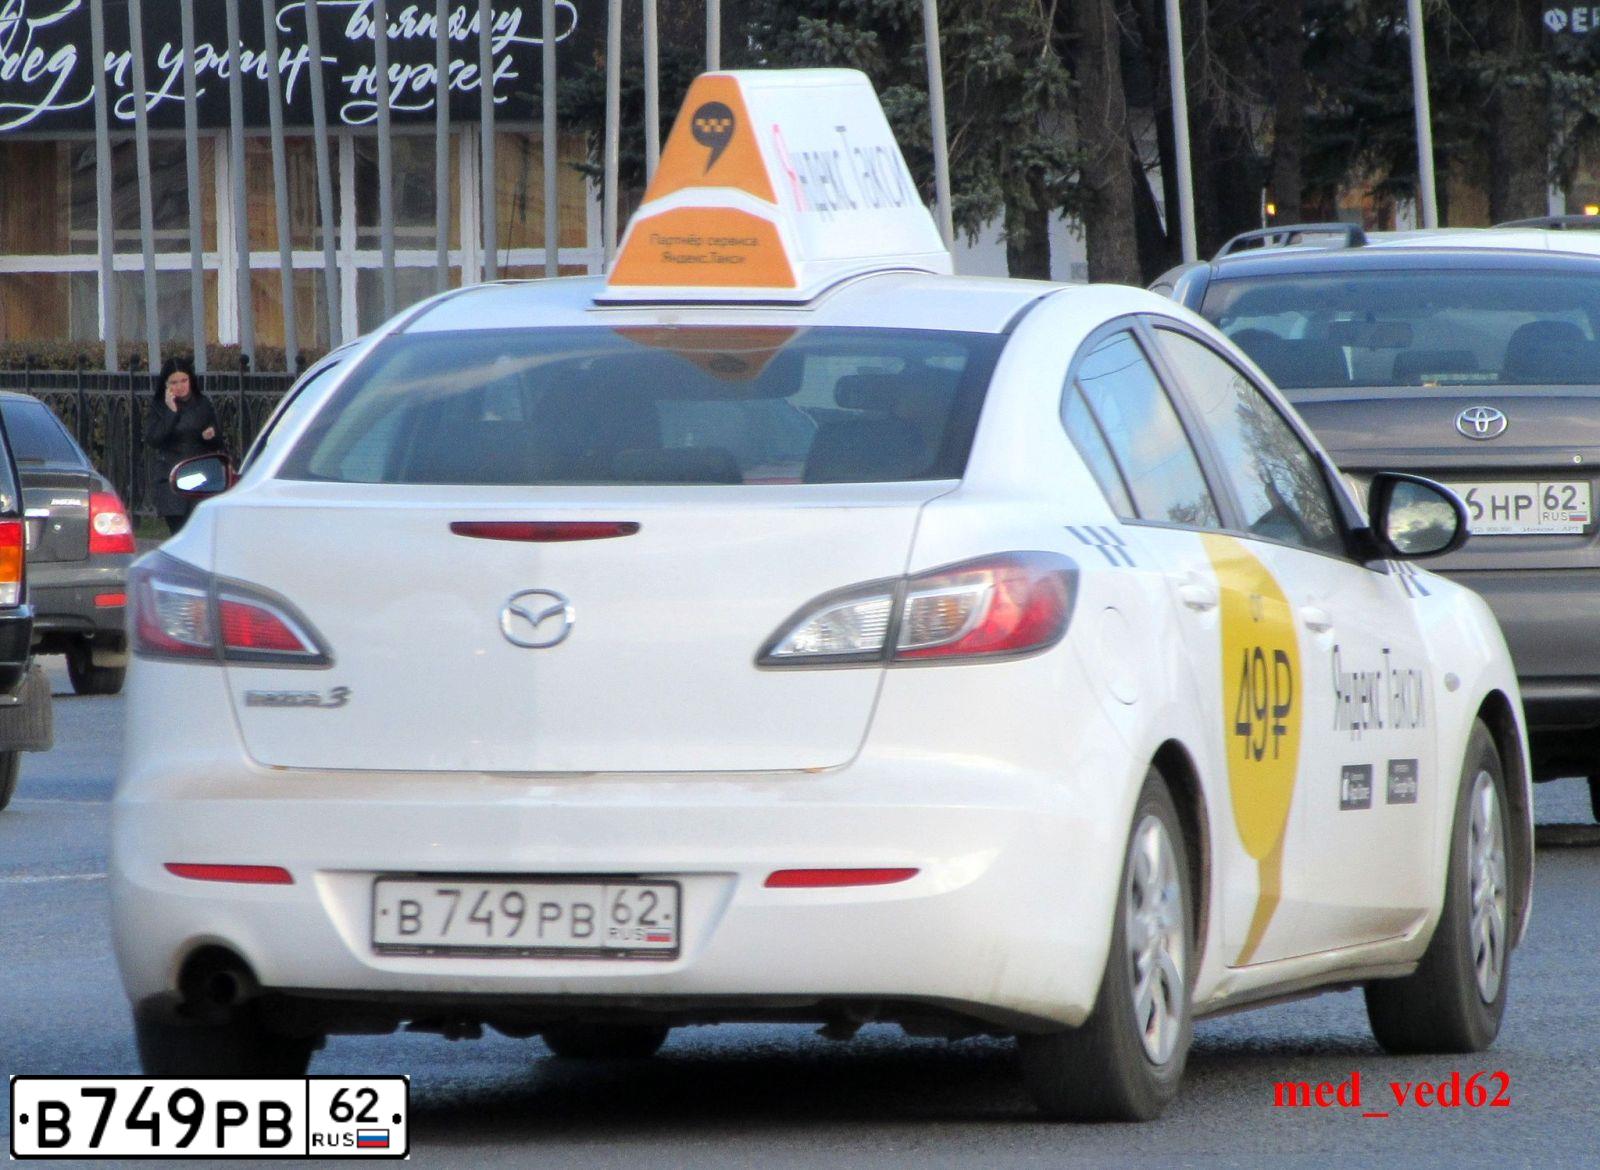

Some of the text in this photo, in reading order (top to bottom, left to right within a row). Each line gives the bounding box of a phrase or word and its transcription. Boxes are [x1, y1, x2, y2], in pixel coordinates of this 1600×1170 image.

[1543, 485, 1577, 510] 62
[1542, 512, 1568, 521] RUS
[611, 889, 657, 926] 62
[609, 928, 645, 941] RUS
